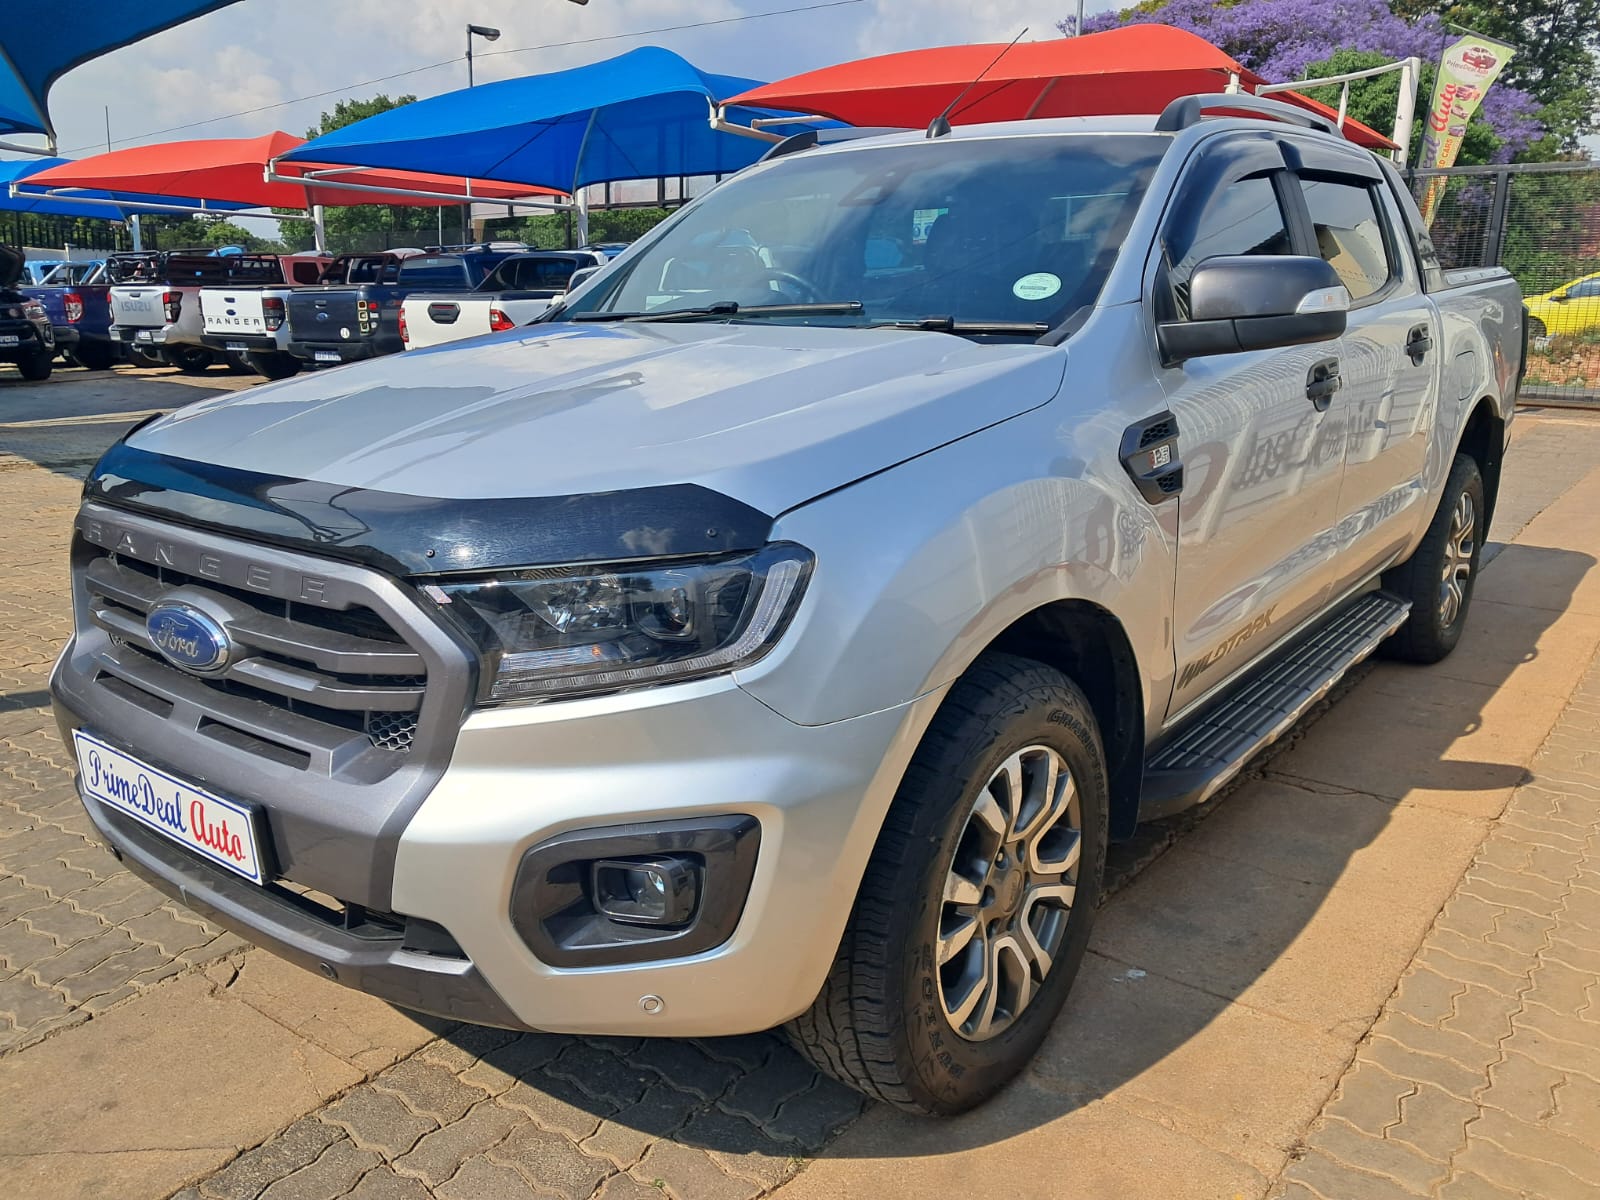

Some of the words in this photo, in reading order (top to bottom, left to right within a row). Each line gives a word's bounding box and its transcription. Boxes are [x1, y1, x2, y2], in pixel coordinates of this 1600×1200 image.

[1430, 83, 1457, 132] Auto
[1443, 138, 1454, 158] CARS
[121, 300, 152, 312] ISUZU
[207, 317, 260, 326] RANGER
[86, 521, 329, 603] RANGER
[156, 618, 199, 658] Ford
[1177, 602, 1279, 690] WILDTRAK
[89, 750, 187, 833] PrimeDeal
[190, 800, 246, 861] Auto
